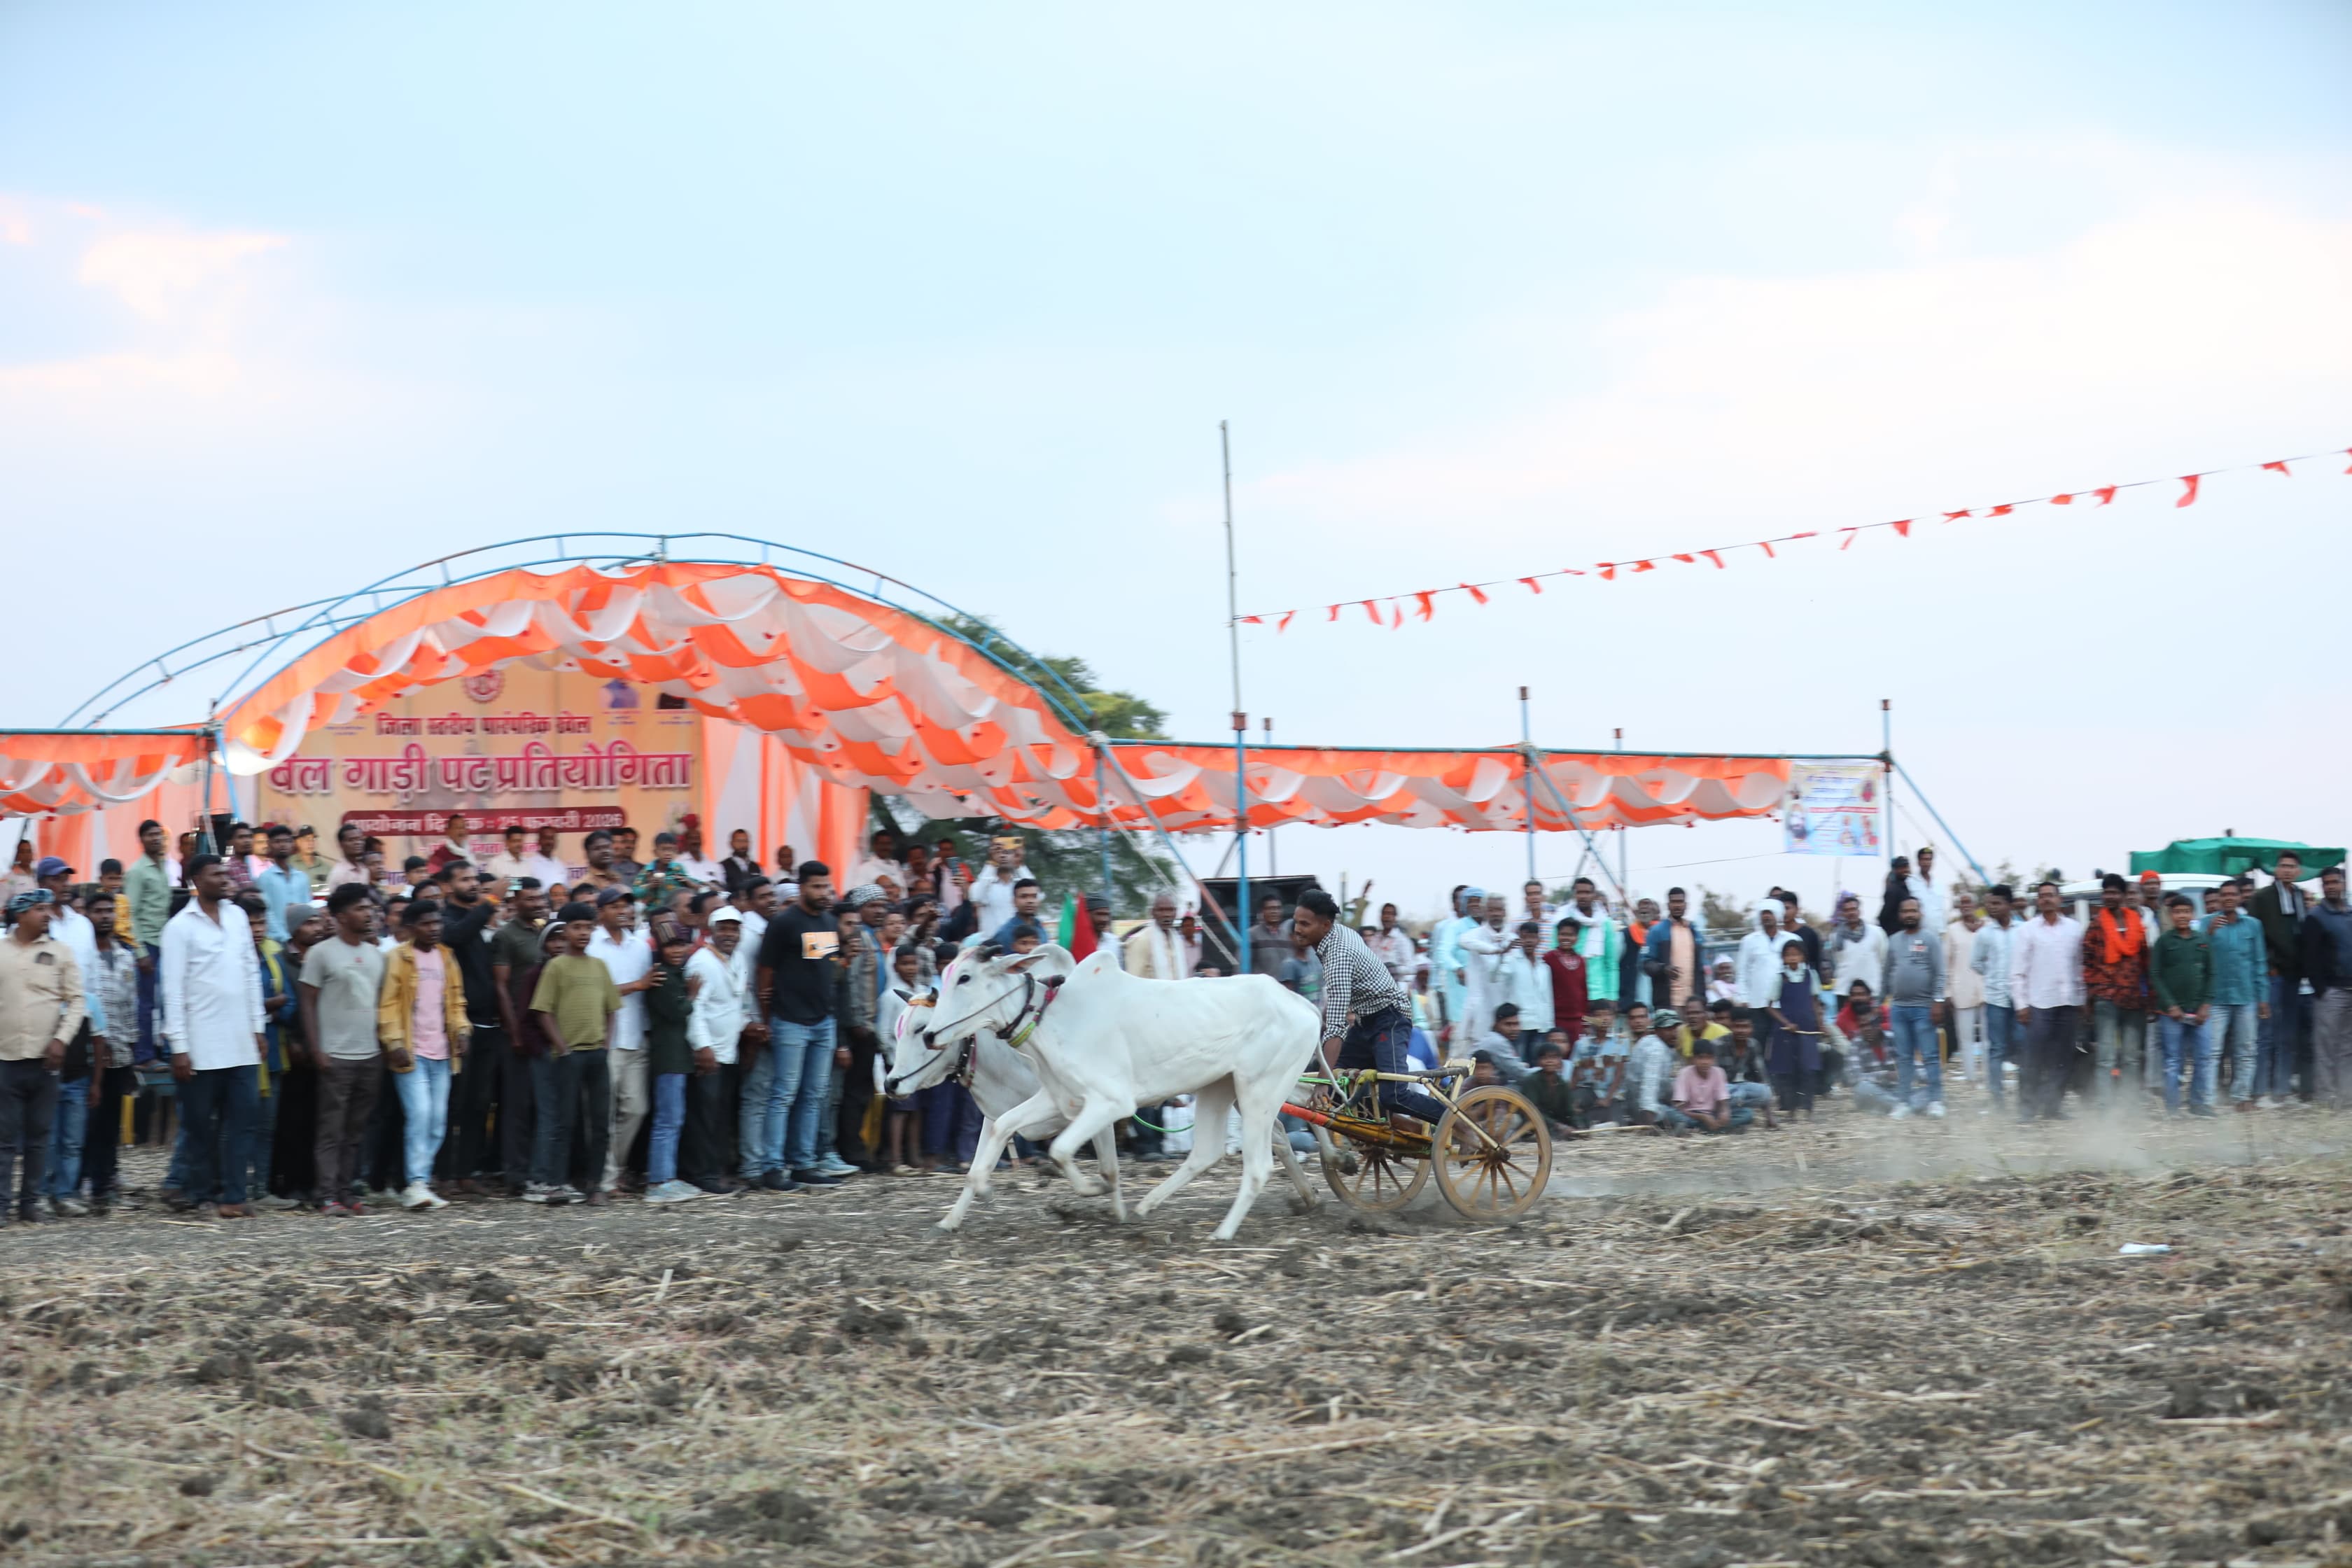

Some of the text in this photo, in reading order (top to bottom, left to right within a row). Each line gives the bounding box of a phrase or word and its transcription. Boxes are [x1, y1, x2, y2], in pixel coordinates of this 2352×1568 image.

[375, 711, 421, 735] जिला
[270, 752, 334, 792] बल
[343, 743, 430, 801] गाड़ी
[493, 739, 693, 791] प्रतियोगिता
